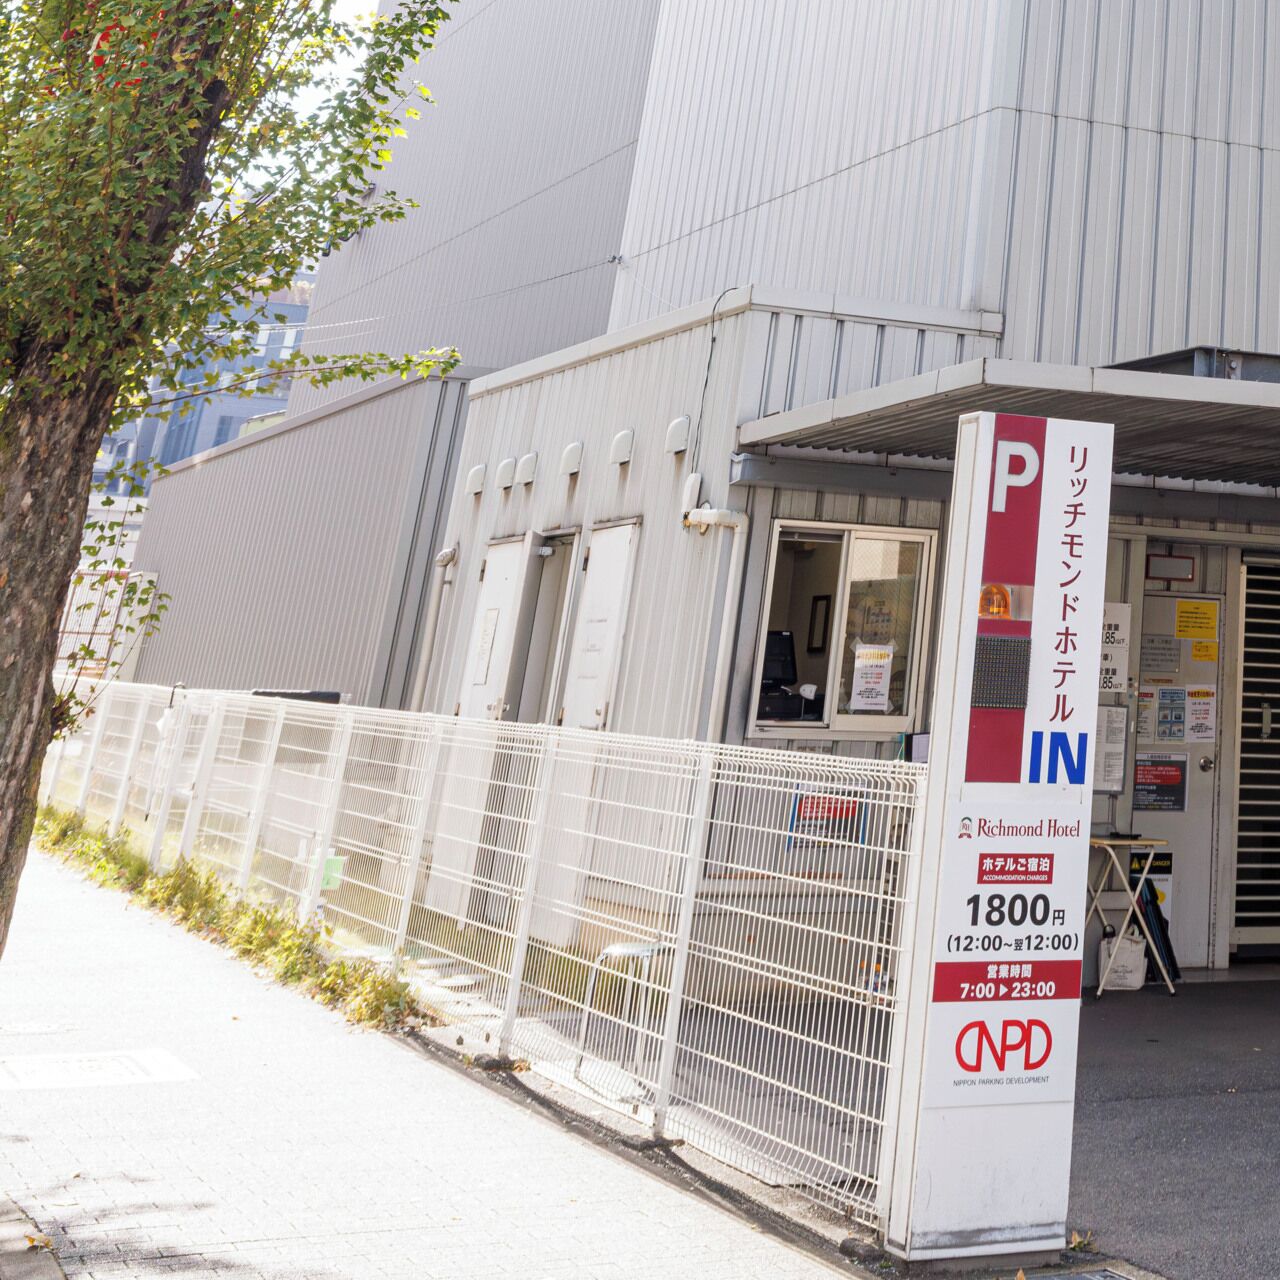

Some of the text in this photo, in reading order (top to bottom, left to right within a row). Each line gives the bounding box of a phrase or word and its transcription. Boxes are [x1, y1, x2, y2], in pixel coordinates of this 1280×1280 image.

[992, 439, 1041, 513] P
[1049, 445, 1089, 723] リッチモンドホテル
[1028, 730, 1088, 785] IN
[978, 818, 1081, 838] Richmond Hotel
[982, 857, 1050, 872] ホテルご宿泊
[987, 964, 1033, 979] 営業時間
[960, 981, 1056, 999] 7:00 23:00
[953, 1076, 1050, 1087] NIPPON PARKING DEVELOPMENT
